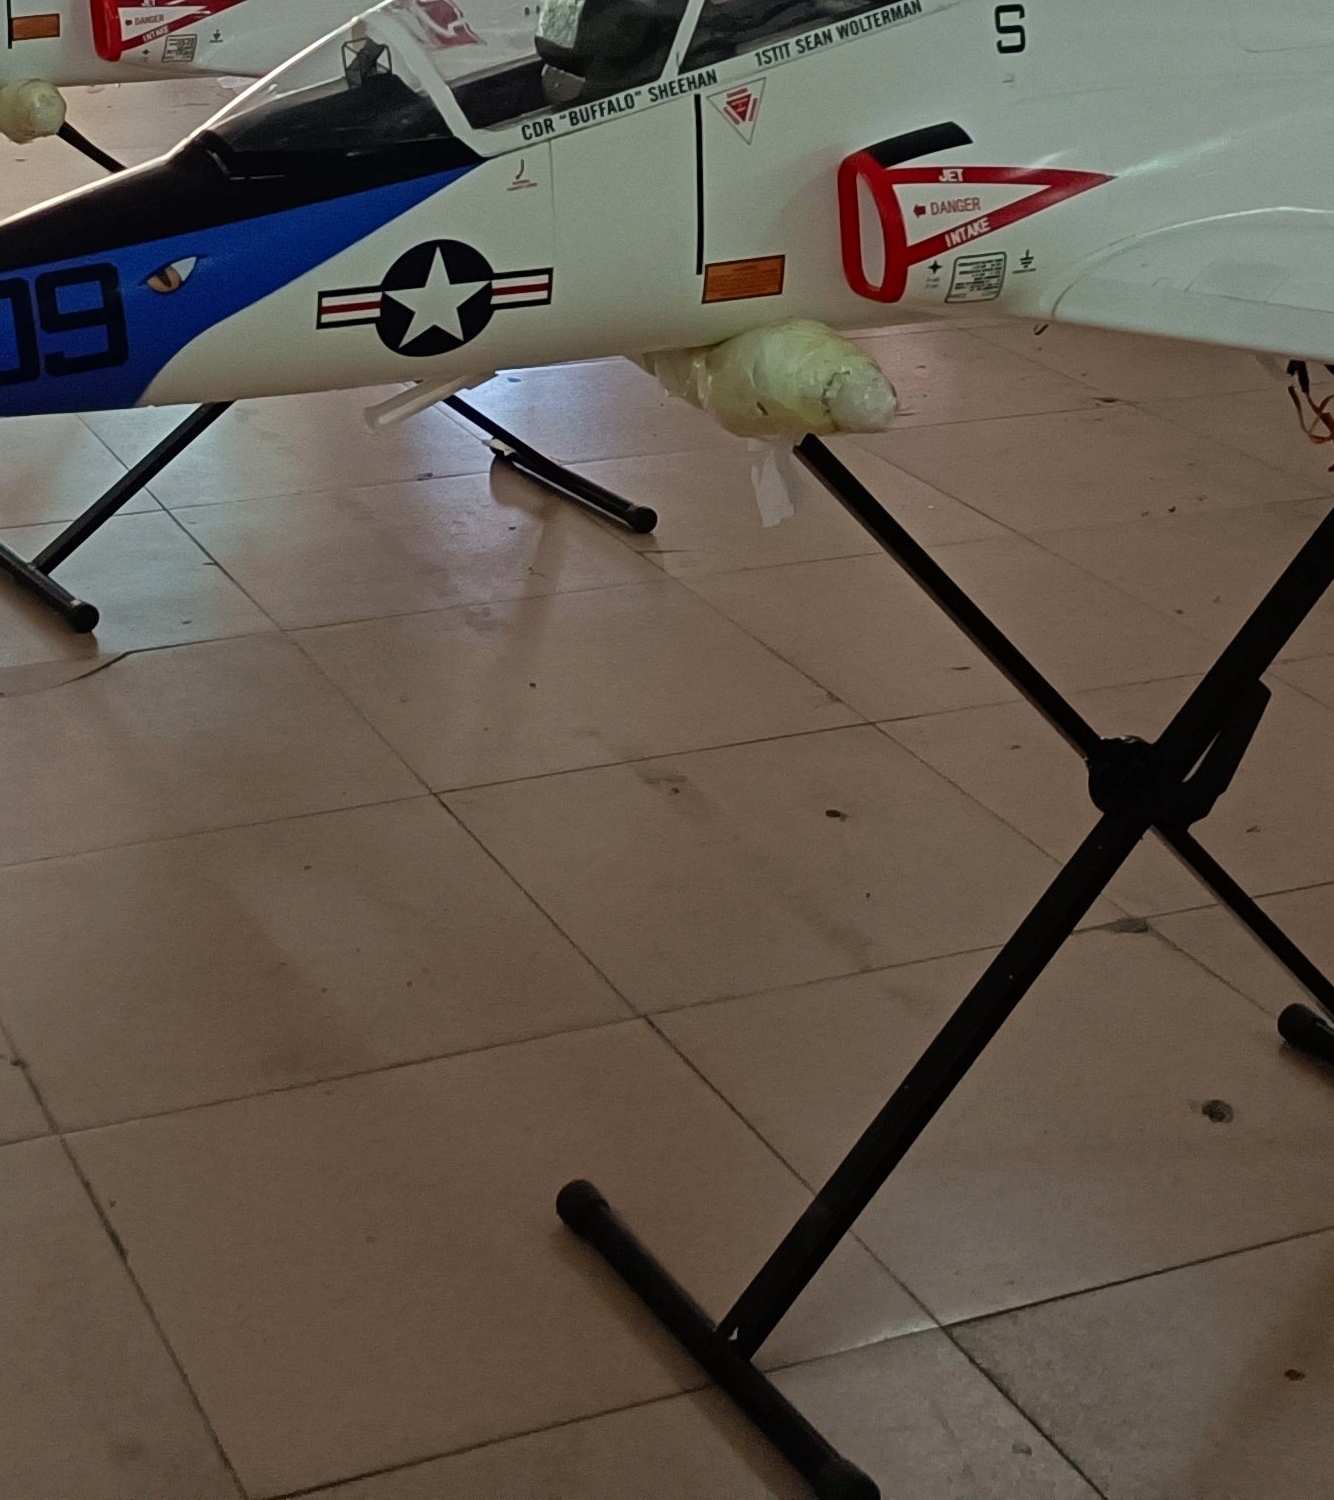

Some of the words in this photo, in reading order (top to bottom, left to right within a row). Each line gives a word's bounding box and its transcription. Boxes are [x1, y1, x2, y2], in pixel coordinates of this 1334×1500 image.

[795, 28, 834, 55] SEAN
[994, 4, 1026, 54] S
[521, 118, 556, 141] CDR
[649, 69, 718, 102] SHEEHAN
[938, 168, 964, 183] JET
[930, 197, 981, 216] DANGER
[944, 216, 991, 248] INTAKE
